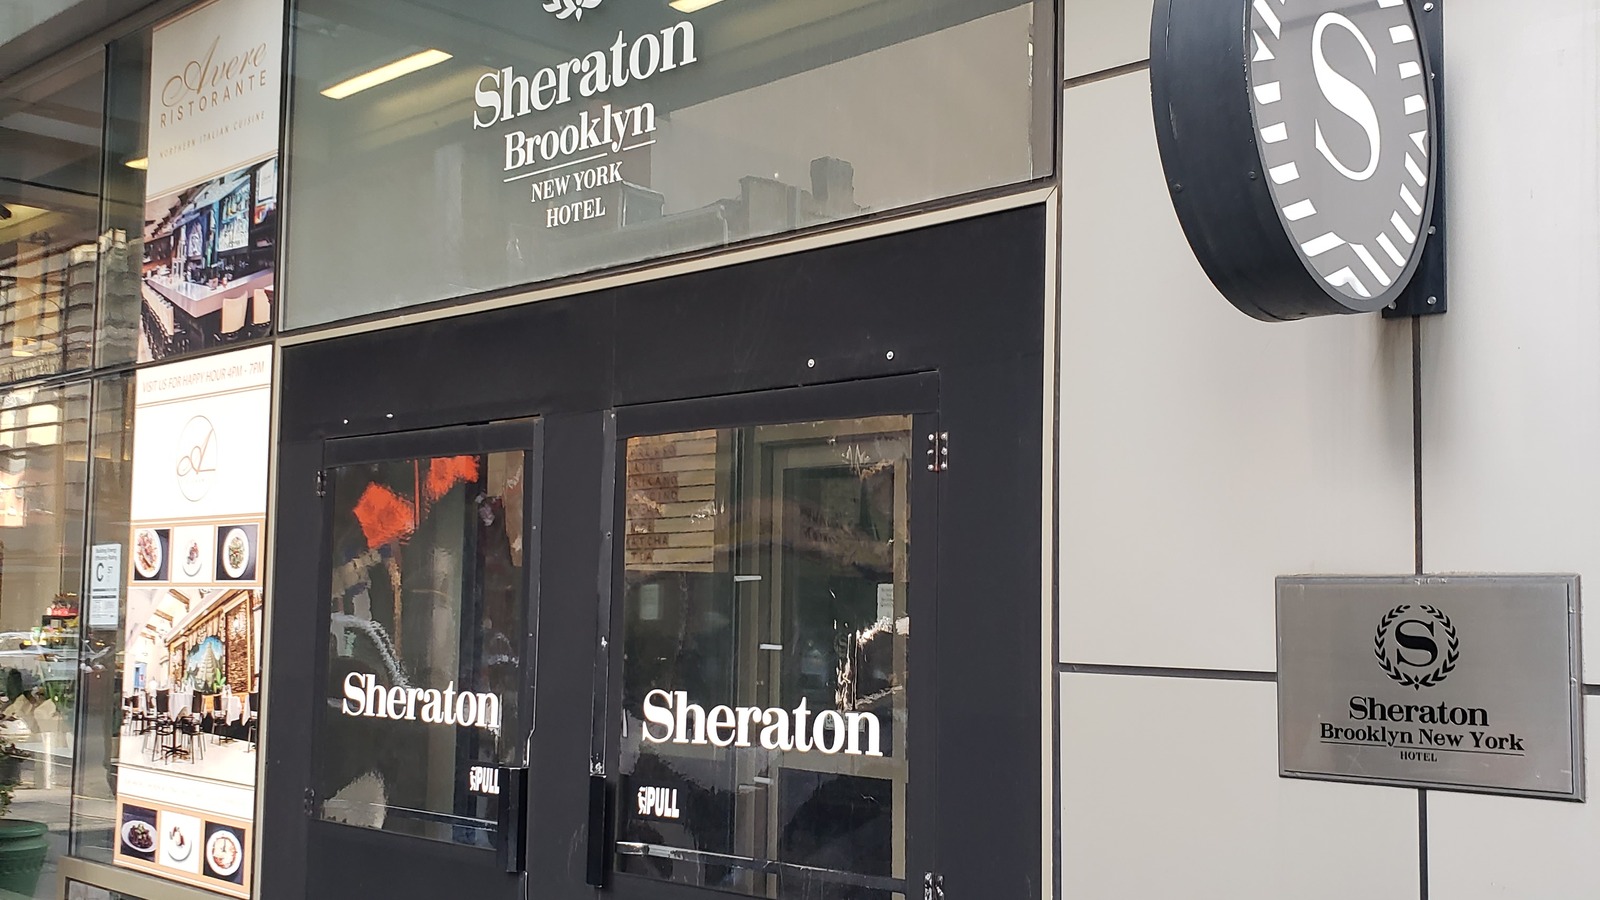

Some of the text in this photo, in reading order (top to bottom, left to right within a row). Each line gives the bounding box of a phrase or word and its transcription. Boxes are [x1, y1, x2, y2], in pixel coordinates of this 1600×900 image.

[162, 35, 267, 108] Avere
[473, 20, 698, 130] Sheraton
[160, 69, 267, 128] RISTORANTE
[1311, 11, 1381, 181] S
[159, 110, 265, 158] NORTHERN ITALIAN CUISINE
[503, 102, 657, 171] Brooklyn
[530, 161, 624, 203] NEW YORK
[546, 197, 606, 228] HOTEL
[142, 380, 158, 393] VISIT
[158, 378, 168, 391] US
[168, 375, 182, 390] FOR
[182, 371, 205, 387] HAPPY
[205, 368, 226, 383] HOUR
[227, 364, 243, 377] 4PM
[249, 360, 265, 375] 7PM
[96, 562, 104, 582] C
[1394, 619, 1439, 667] S
[341, 671, 500, 729] Sheraton
[642, 688, 884, 757] Sheraton
[1348, 696, 1490, 727] Sheraton
[1319, 722, 1526, 752] Brooklyn New York
[1399, 751, 1439, 763] HOTEL
[476, 766, 500, 794] PULL
[646, 786, 680, 818] PULL
